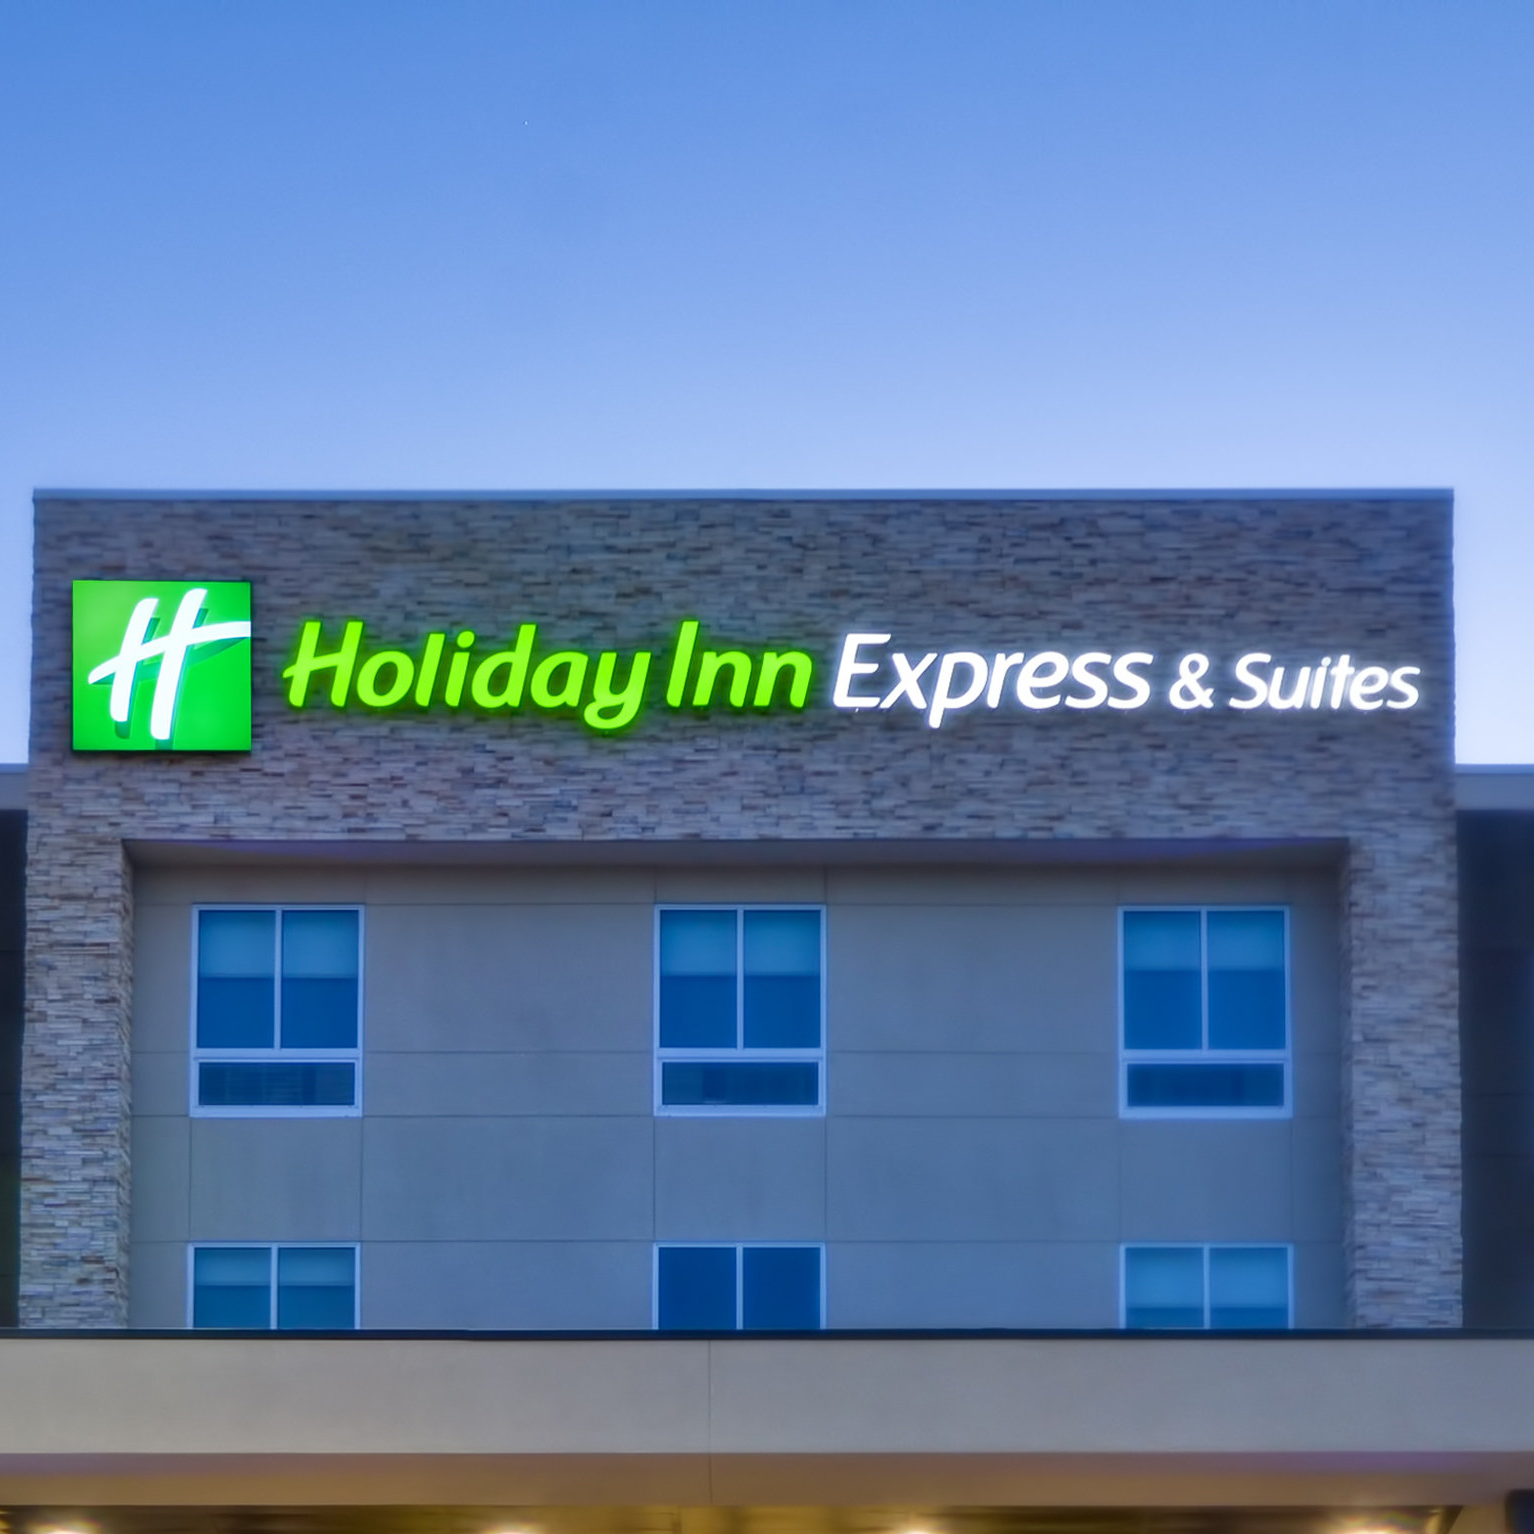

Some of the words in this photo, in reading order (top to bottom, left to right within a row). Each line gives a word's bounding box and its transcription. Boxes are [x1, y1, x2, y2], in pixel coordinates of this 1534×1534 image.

[283, 621, 651, 729] Holiday
[667, 621, 812, 707] Inn
[833, 633, 1153, 728] Express
[1169, 652, 1214, 709] &
[1229, 652, 1421, 710] Suites
